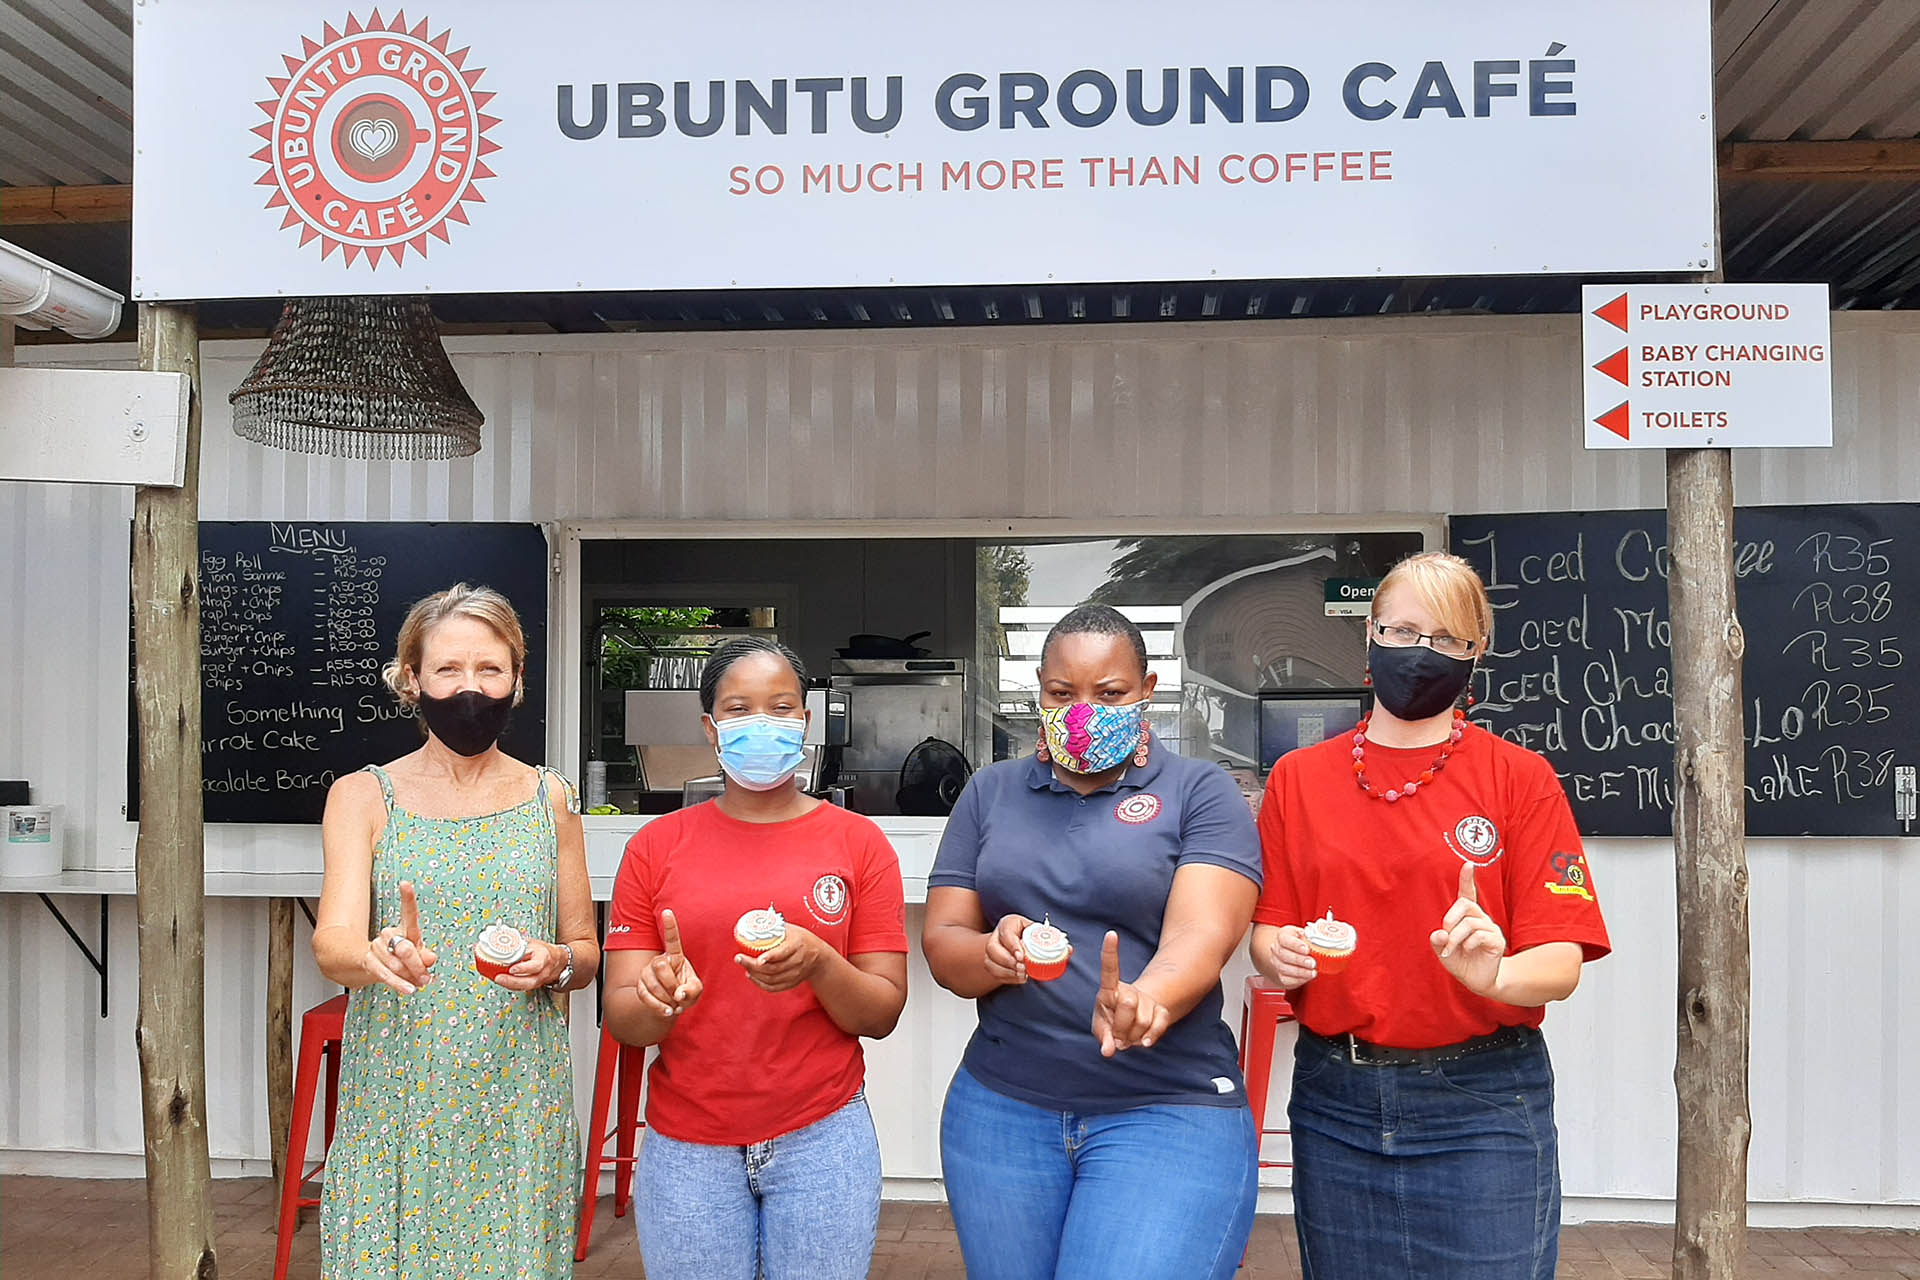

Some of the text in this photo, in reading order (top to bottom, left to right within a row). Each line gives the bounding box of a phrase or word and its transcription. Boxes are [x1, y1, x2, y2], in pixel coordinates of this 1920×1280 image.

[557, 41, 1577, 140] UBUNTU GROUND CAFÉ
[284, 43, 467, 189] UBUNTU GROUND
[729, 151, 1393, 195] SO MUCH MORE THAN COFFEE
[322, 192, 424, 236] CAFÉ
[1640, 304, 1790, 320] PLAYGROUND
[1641, 345, 1824, 361] BABY CHANGING
[1641, 370, 1731, 387] STATION
[1642, 411, 1728, 428] TOILETS
[202, 549, 262, 571] Egg Roll
[1462, 529, 1585, 589] Iced
[1795, 531, 1894, 576] R35
[1340, 584, 1375, 599] Open
[1792, 581, 1893, 624] R38
[201, 609, 224, 625] rap
[1782, 629, 1903, 672] R35
[200, 662, 234, 679] rger
[227, 695, 421, 733] Something Swee
[1801, 680, 1895, 731] R35
[263, 730, 320, 751] Cake
[201, 767, 270, 793] ocolate
[1819, 744, 1896, 804] R38
